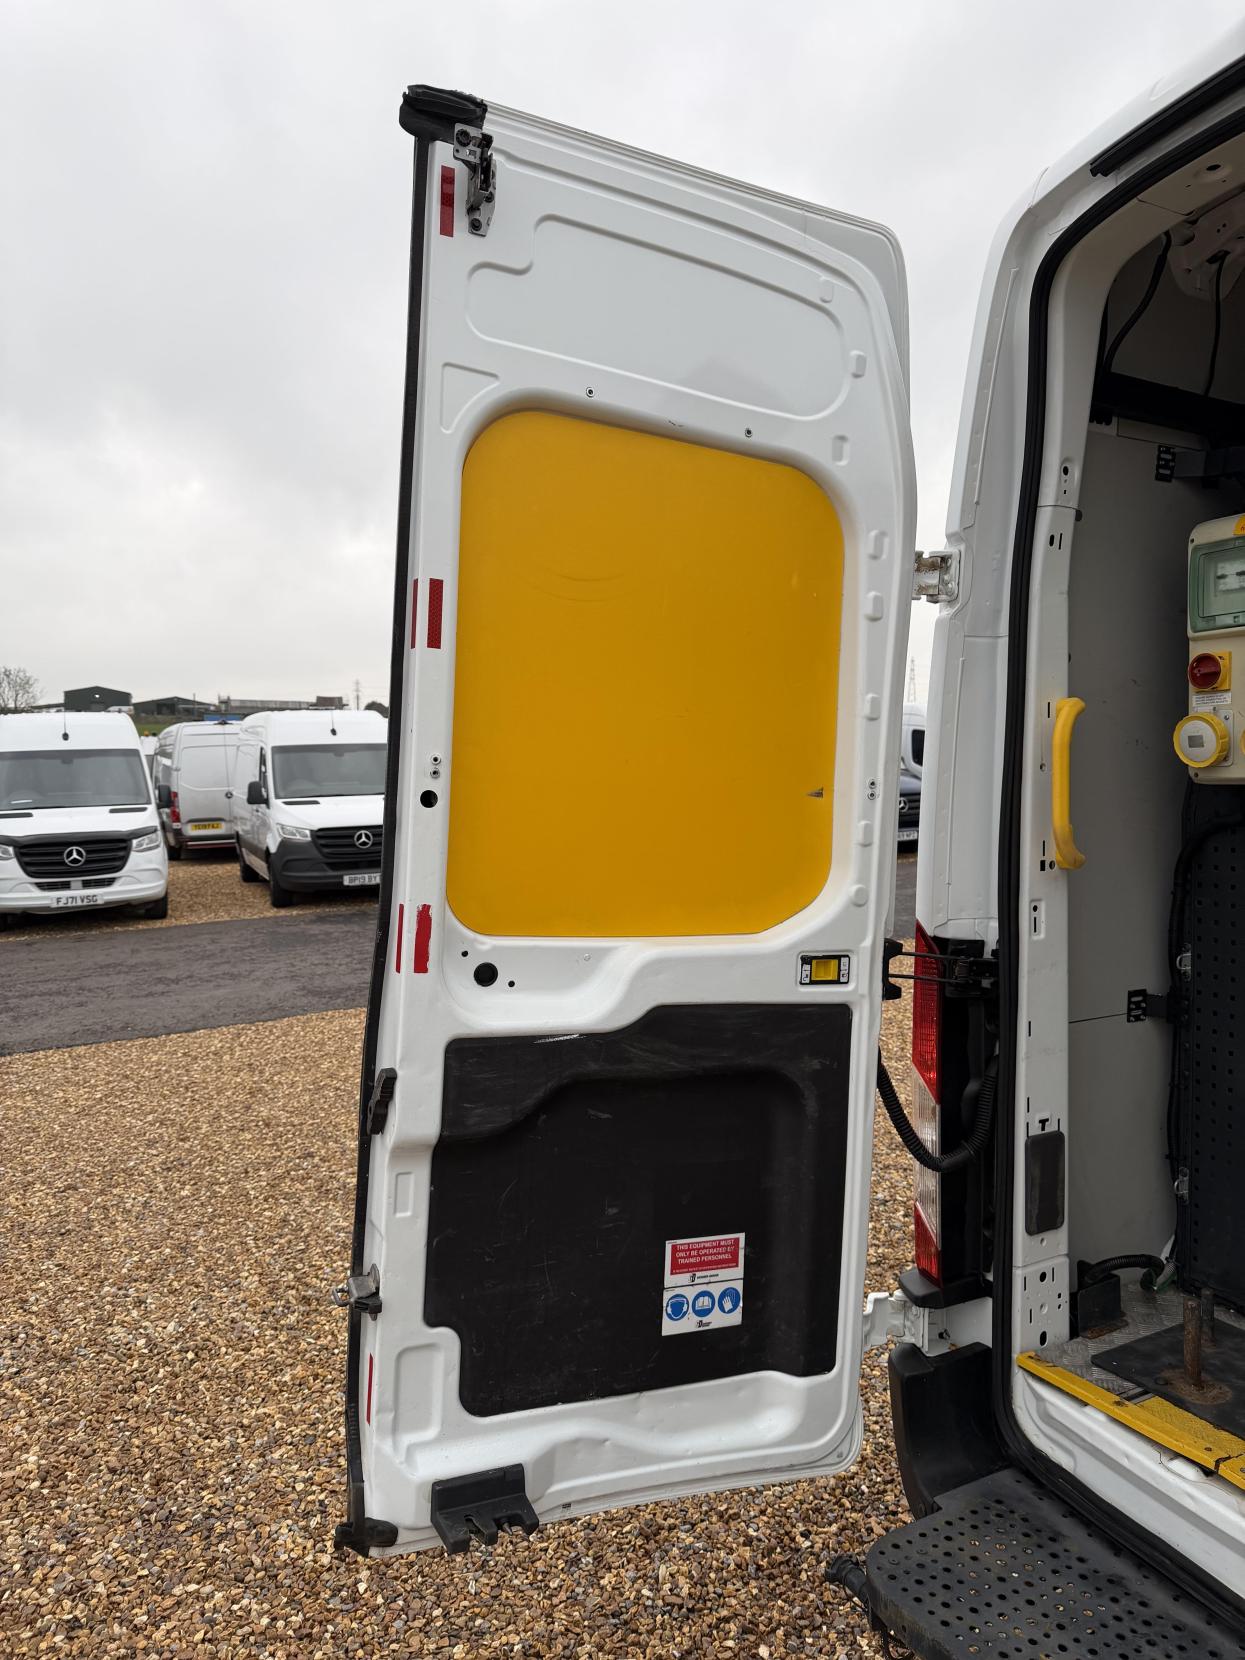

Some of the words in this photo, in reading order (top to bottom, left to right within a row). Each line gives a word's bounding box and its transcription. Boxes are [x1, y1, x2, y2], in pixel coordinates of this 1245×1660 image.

[56, 896, 78, 905] FJ71
[80, 894, 98, 904] VSG
[689, 1241, 719, 1249] EQUIPMENT
[698, 1246, 726, 1255] OPERATED
[678, 1256, 700, 1264] TRAINED
[702, 1253, 732, 1262] PERSONNEL
